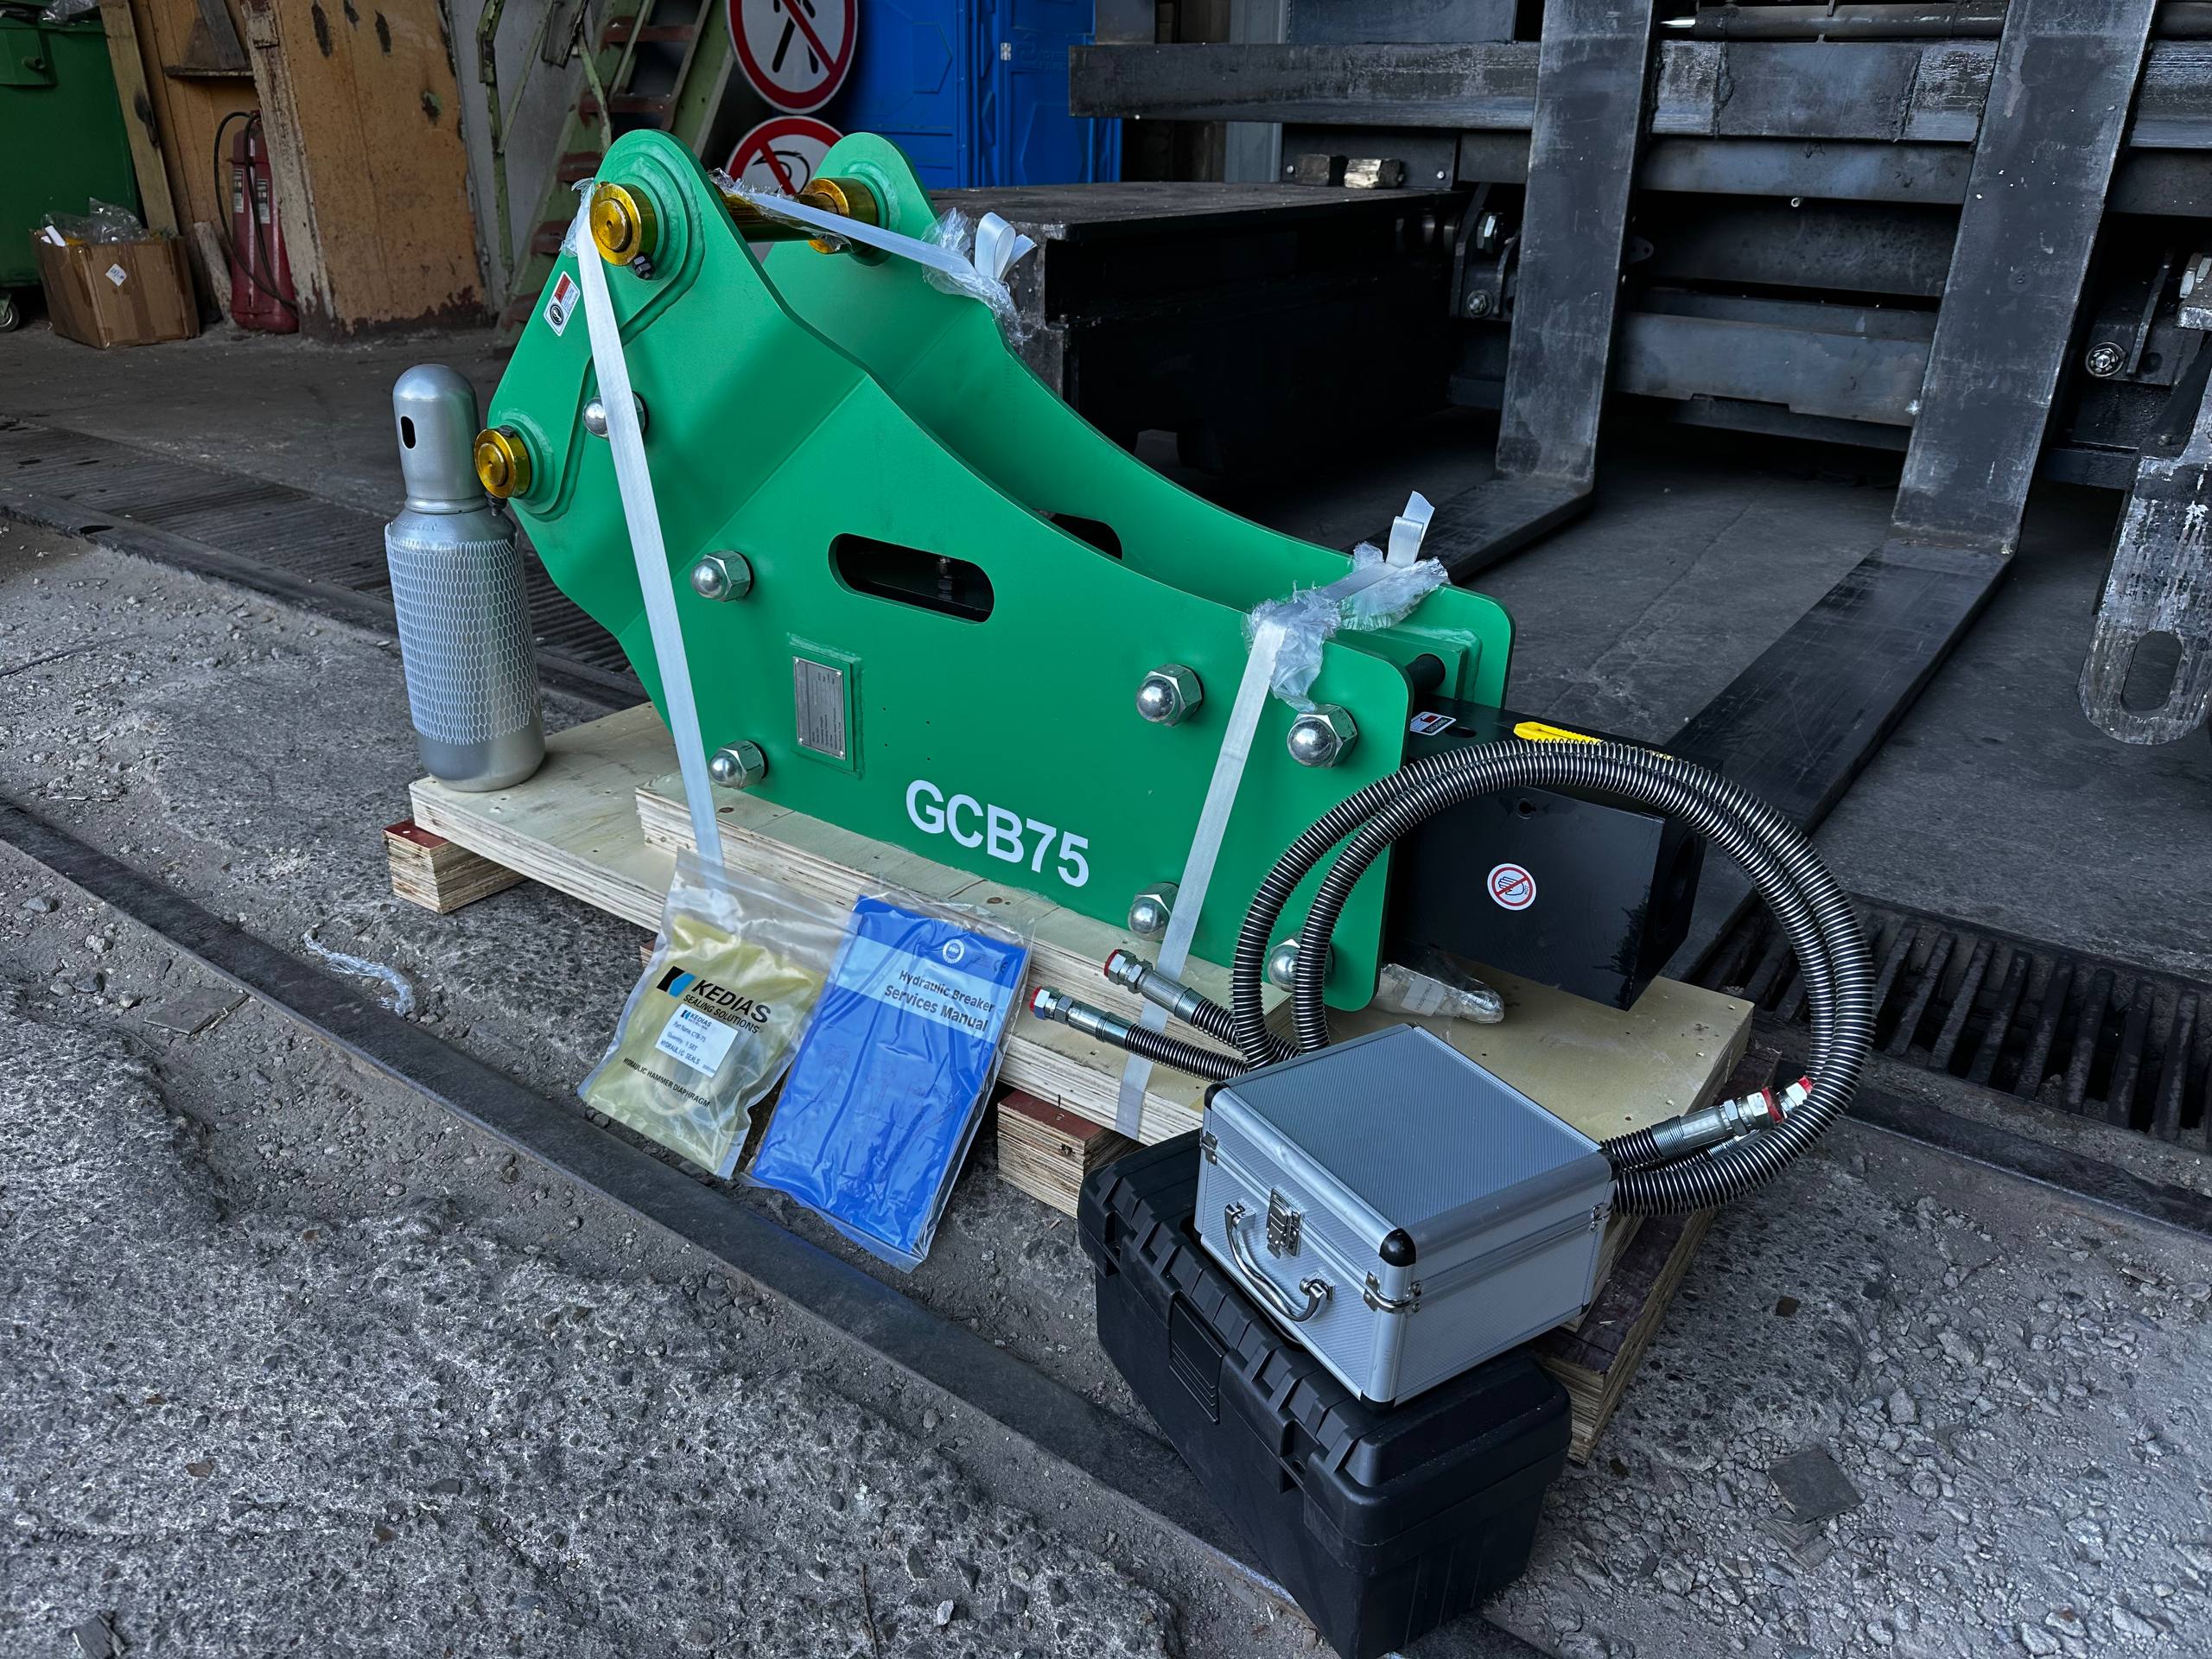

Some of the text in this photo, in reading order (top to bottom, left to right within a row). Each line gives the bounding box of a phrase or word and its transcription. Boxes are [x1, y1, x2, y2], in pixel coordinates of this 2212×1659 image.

[906, 779, 1090, 887] GCB75
[683, 995, 715, 1013] SEALING
[714, 1007, 760, 1034] SOLUTIONS
[690, 1013, 713, 1027] KEDIAS
[691, 979, 772, 1023] KEDIAS
[885, 984, 988, 1033] Services Manual
[951, 989, 995, 1013] Breaker
[660, 1039, 702, 1065] HYDRAULIC SEALS
[622, 1057, 711, 1108] HYDRAULIC HAMMER DIAPHRAGM
